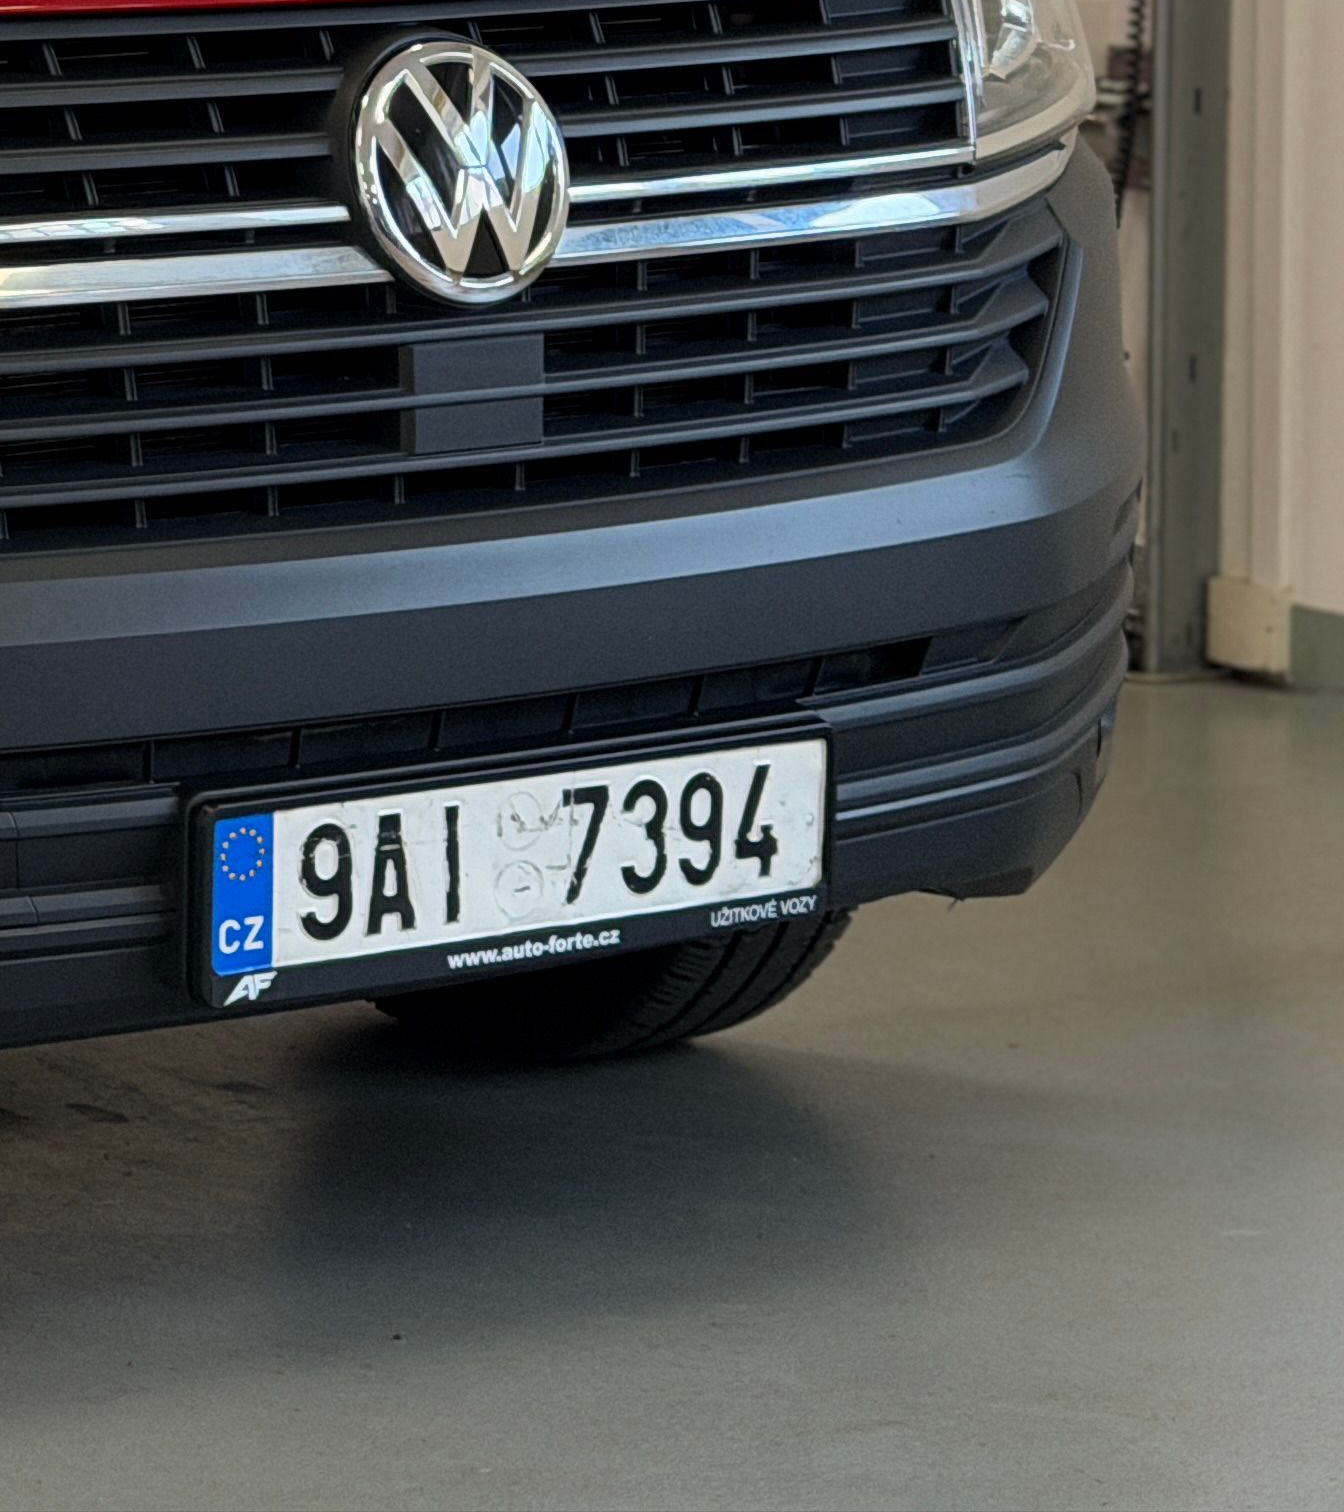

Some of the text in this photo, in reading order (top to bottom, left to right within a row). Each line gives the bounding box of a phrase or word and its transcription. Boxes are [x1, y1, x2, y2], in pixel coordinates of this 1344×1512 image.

[299, 764, 779, 940] 9AI 7394
[710, 895, 817, 928] UŽITKOVÉ VOZY
[219, 915, 264, 955] CZ
[447, 929, 621, 969] www.auto-forte.cz
